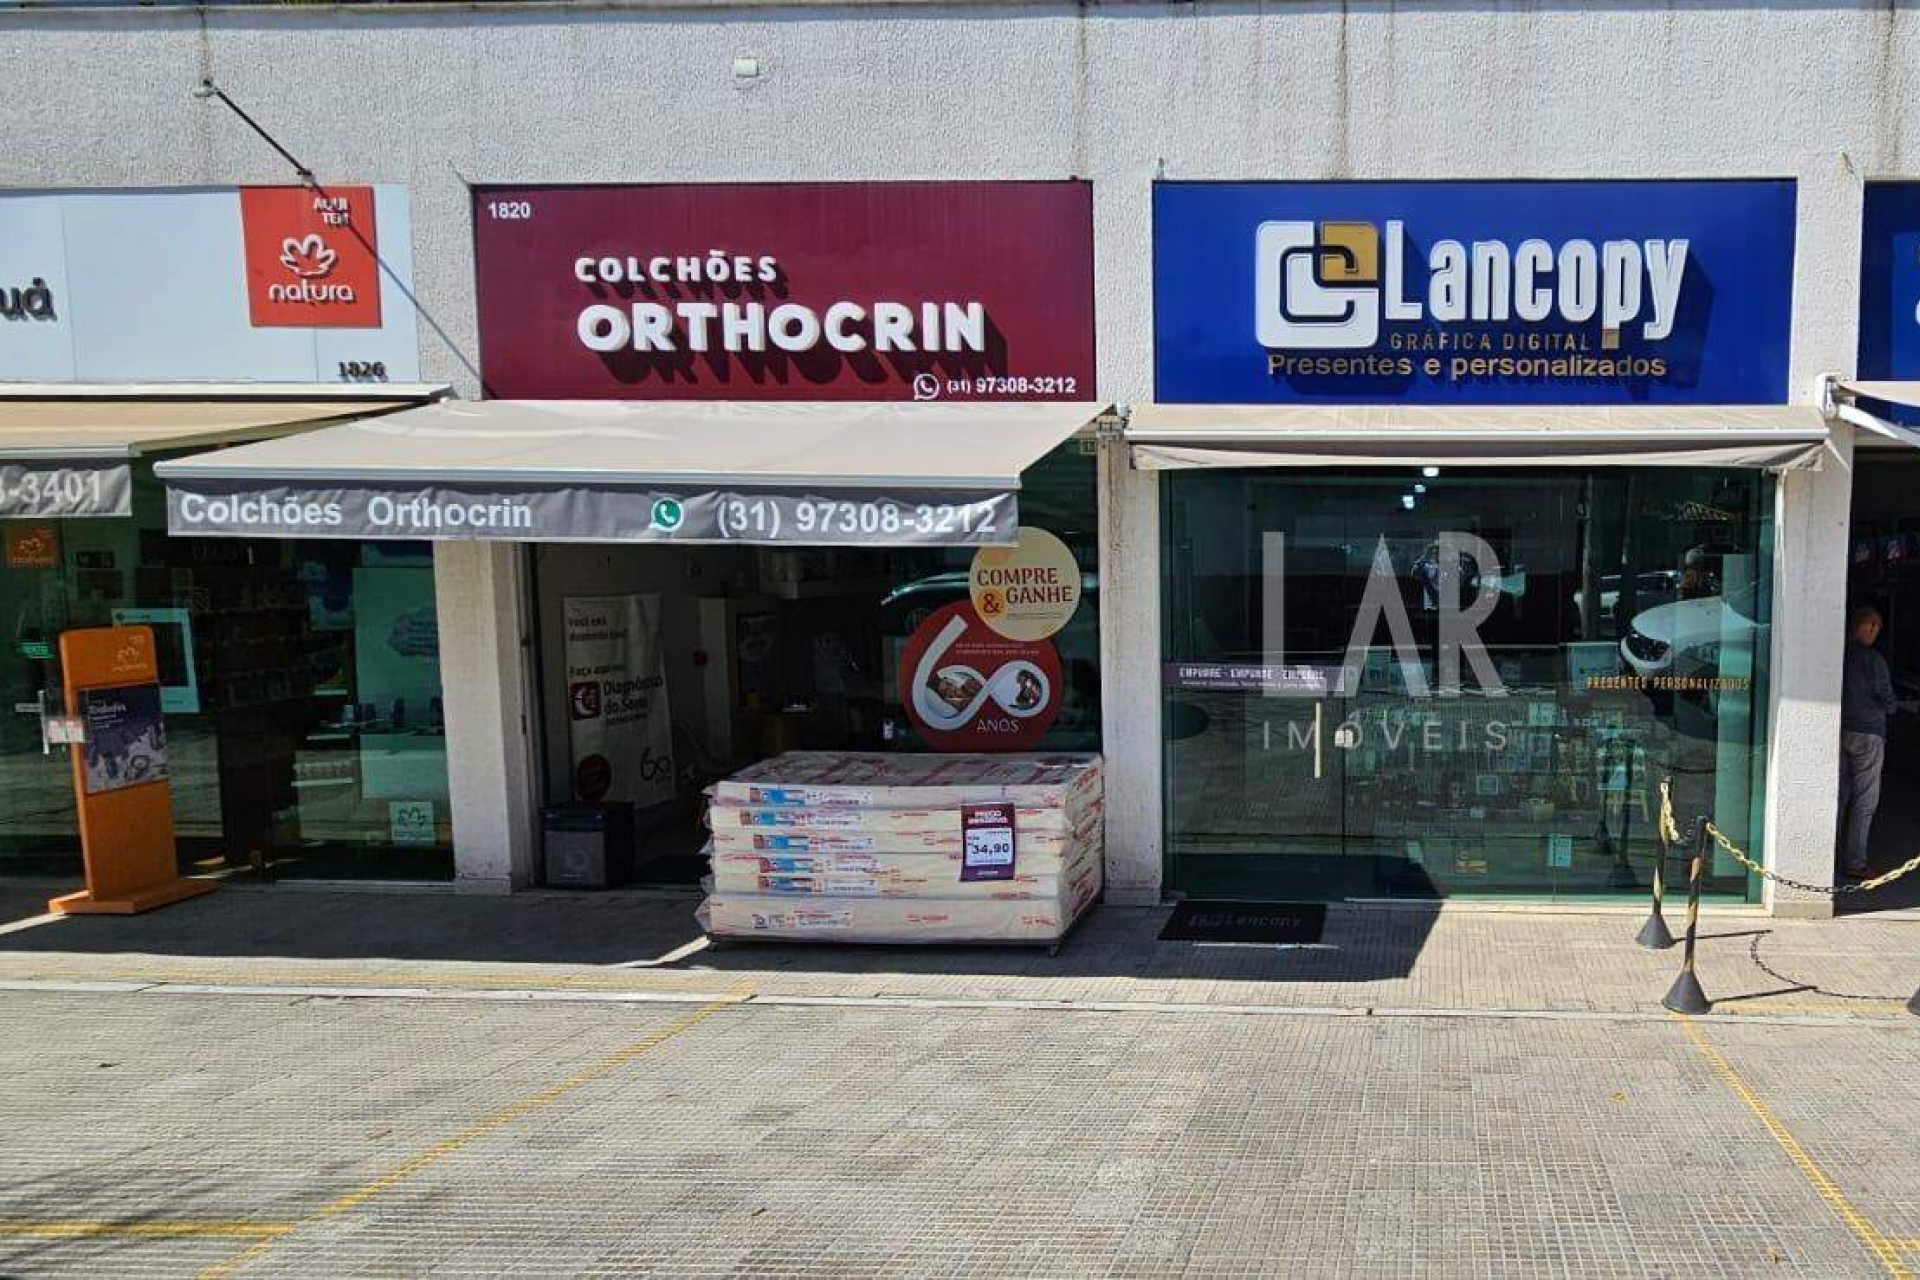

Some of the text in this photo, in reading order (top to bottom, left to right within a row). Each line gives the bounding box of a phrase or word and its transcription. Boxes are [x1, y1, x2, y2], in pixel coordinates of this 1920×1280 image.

[487, 202, 531, 219] 1820
[573, 249, 777, 283] COLCHÕES
[269, 279, 354, 302] natura
[1384, 220, 1690, 349] Lancopy
[576, 301, 986, 353] ORTHOCRIN
[1390, 329, 1590, 350] GRÁFICA DIGITAL
[337, 361, 386, 377] 1826
[1268, 354, 1667, 382] Presentes e personalizados
[947, 376, 1076, 394] (31) 97308-3212
[181, 493, 997, 540] Colchões Orthocrin (31) 97308-3212
[976, 567, 1059, 586] COMPRE
[983, 586, 1073, 614] & GANHE
[976, 718, 1020, 734] ANOS
[971, 842, 1010, 856] 34,90
